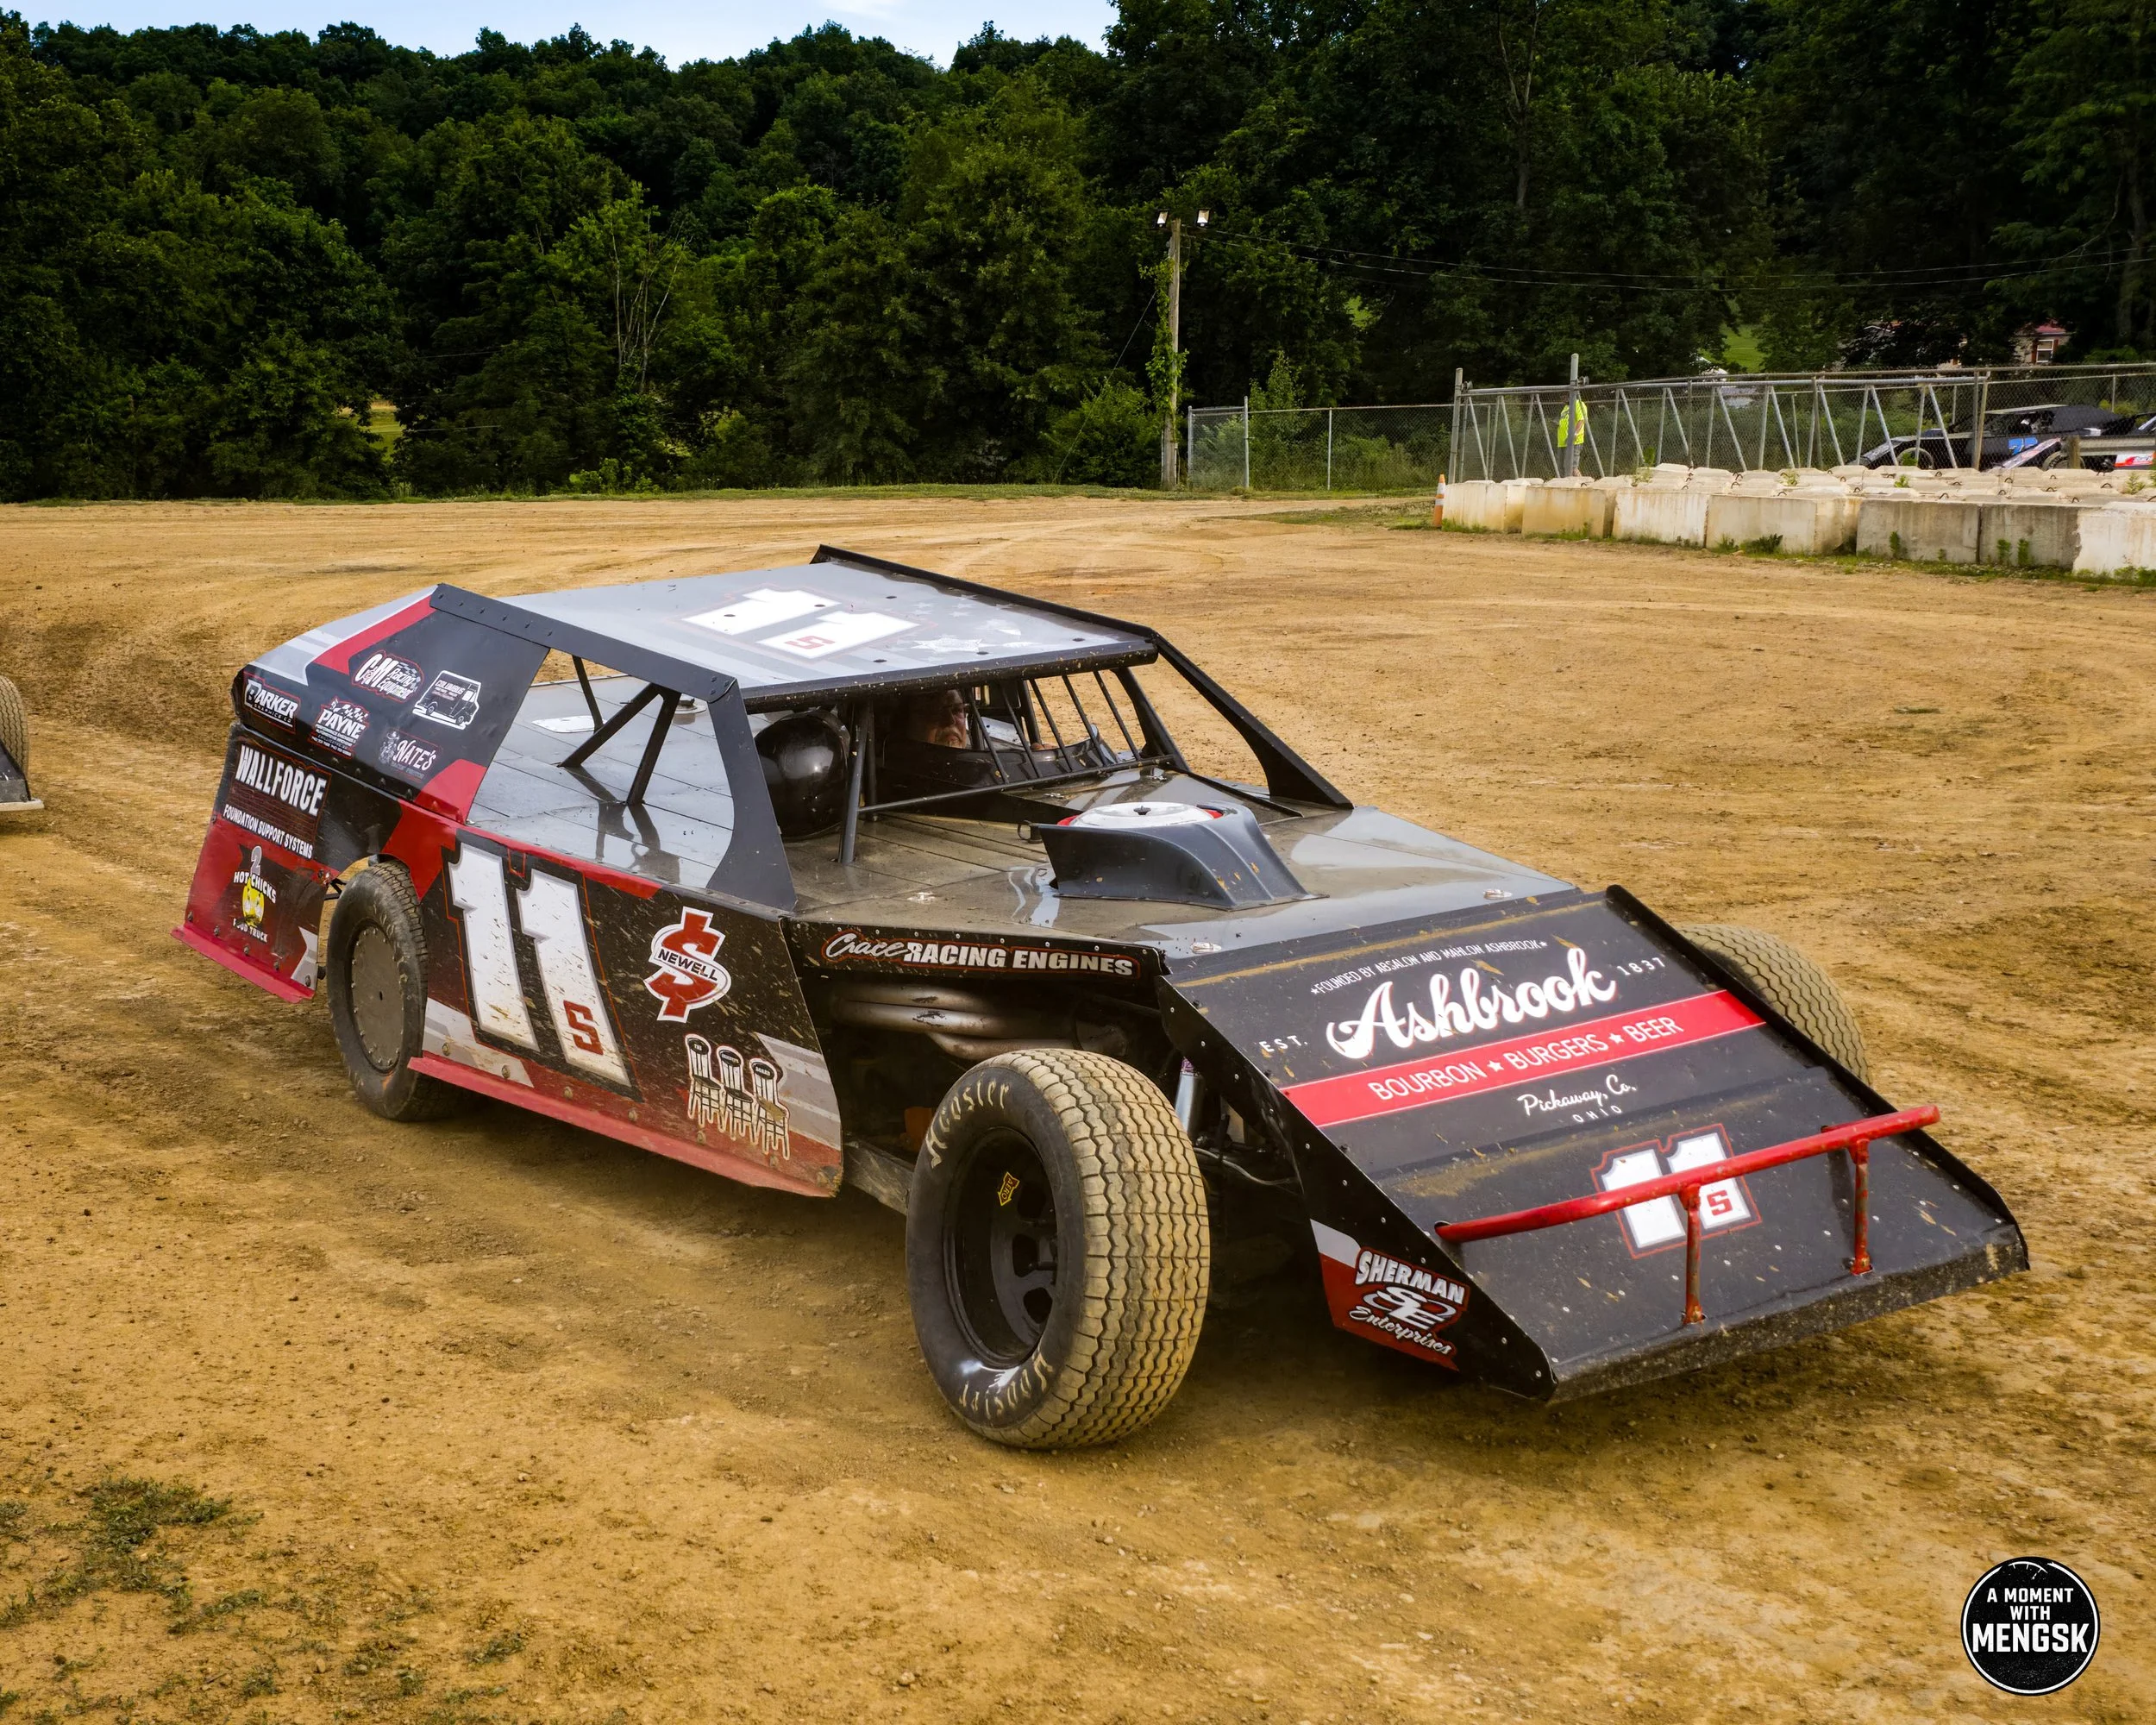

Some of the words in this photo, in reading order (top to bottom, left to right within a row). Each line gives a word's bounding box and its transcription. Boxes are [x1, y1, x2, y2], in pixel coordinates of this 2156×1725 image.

[681, 588, 921, 660] 11
[387, 668, 417, 687] Racing
[244, 679, 298, 719] PARKER
[317, 708, 367, 740] PAYNE
[392, 739, 436, 771] NATE'S
[235, 743, 327, 817] WALLFORCE
[223, 804, 260, 833] FOUNDATION
[258, 820, 285, 845] SUPPORT
[284, 833, 313, 859] SYSTEMS
[234, 871, 250, 884] HOT
[251, 873, 276, 904] CHICKS
[249, 925, 268, 943] TRUCK
[448, 843, 631, 1087] 11
[658, 949, 718, 982] NEWELL
[904, 942, 1006, 968] RACING
[1012, 950, 1133, 975] ENGINES
[1315, 970, 1362, 994] FOUNDED
[1358, 965, 1376, 978] BY
[1375, 955, 1420, 974] ABSALON
[1420, 950, 1442, 963] AND
[1441, 944, 1483, 959] MAHLON
[1484, 939, 1539, 954] ASHBROOK
[1617, 957, 1666, 976] 1837
[1326, 948, 1616, 1059] Ashbrook
[563, 1000, 604, 1055] S
[1259, 1034, 1308, 1053] EST.
[1368, 1062, 1487, 1101] BOURBON
[1503, 1034, 1608, 1070] BURGERS
[1622, 1017, 1684, 1043] BEER
[1517, 1089, 1608, 1116] Pickaway,
[1606, 1074, 1637, 1095] Co.
[1573, 1105, 1622, 1122] OHIO
[1601, 1132, 1751, 1249] 11
[1355, 1250, 1465, 1305] SHERMAN
[1349, 1305, 1452, 1355] Enterprises
